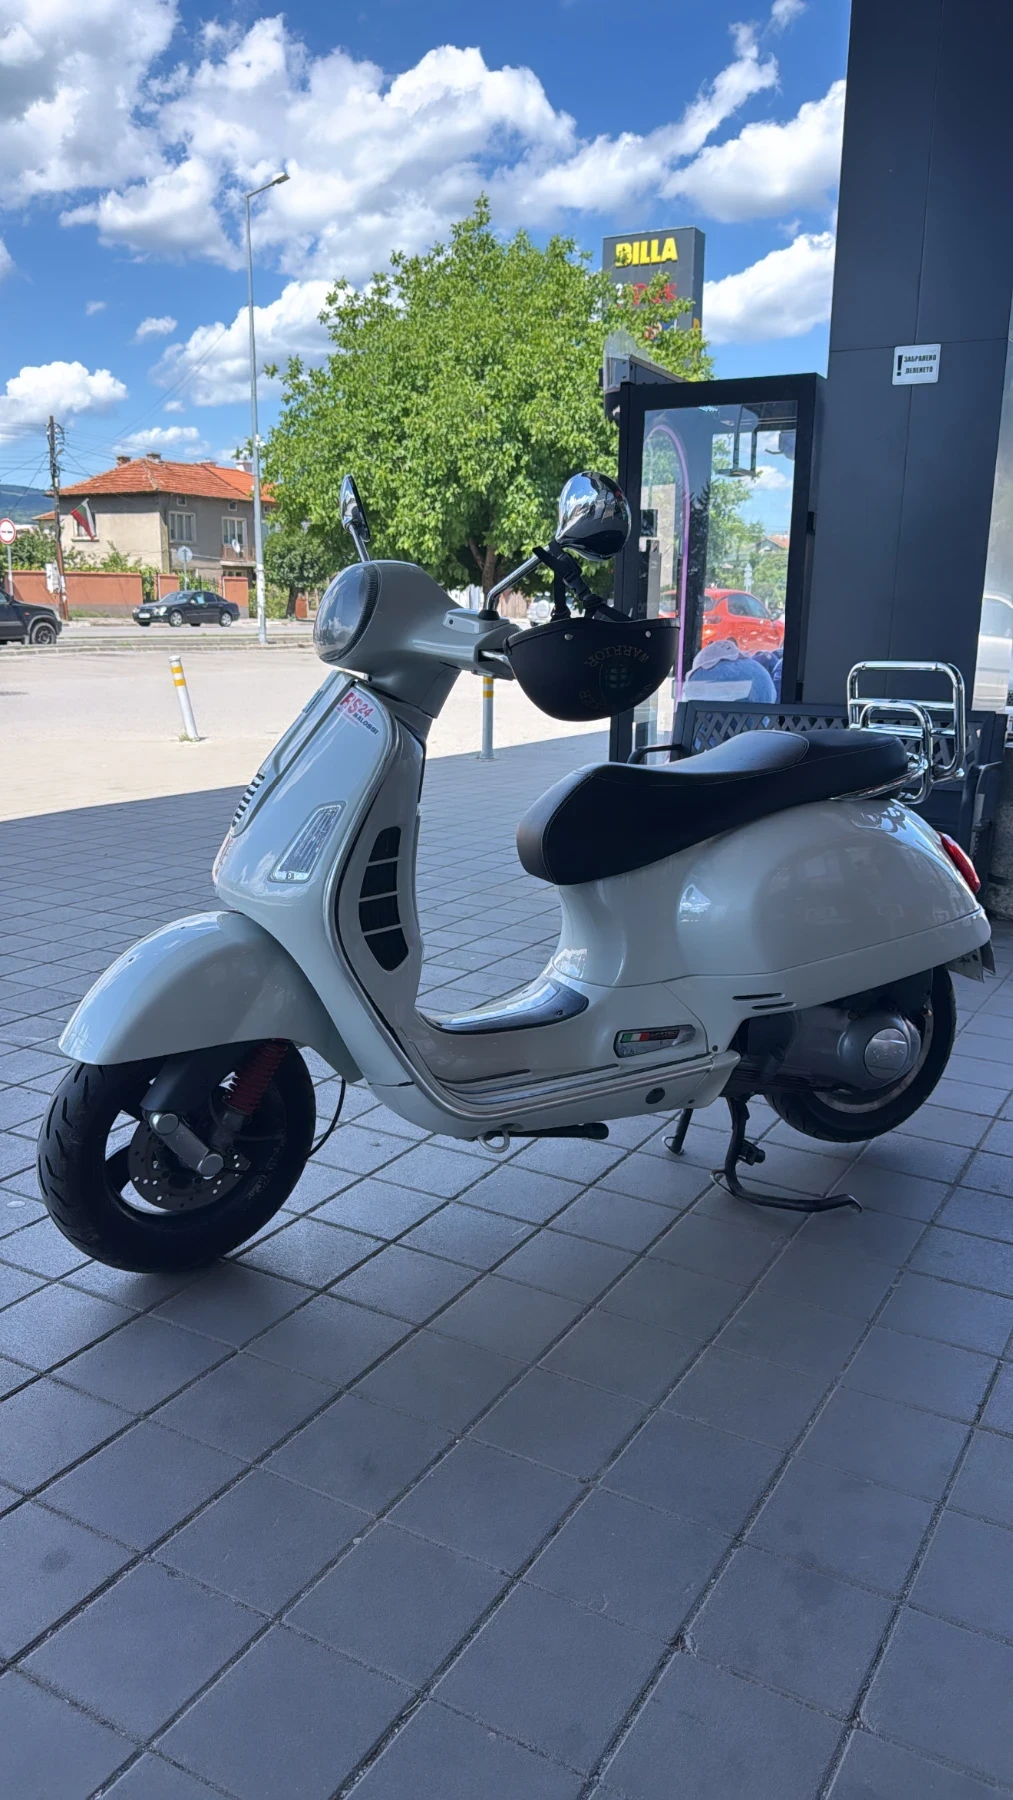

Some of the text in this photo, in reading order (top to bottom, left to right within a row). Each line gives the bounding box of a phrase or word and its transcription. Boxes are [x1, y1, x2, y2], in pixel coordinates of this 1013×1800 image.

[614, 237, 678, 267] BILLA
[904, 354, 936, 362] ЗАБРАНЕНО
[584, 645, 649, 667] WARRIOR
[352, 712, 379, 735] MALOSSI
